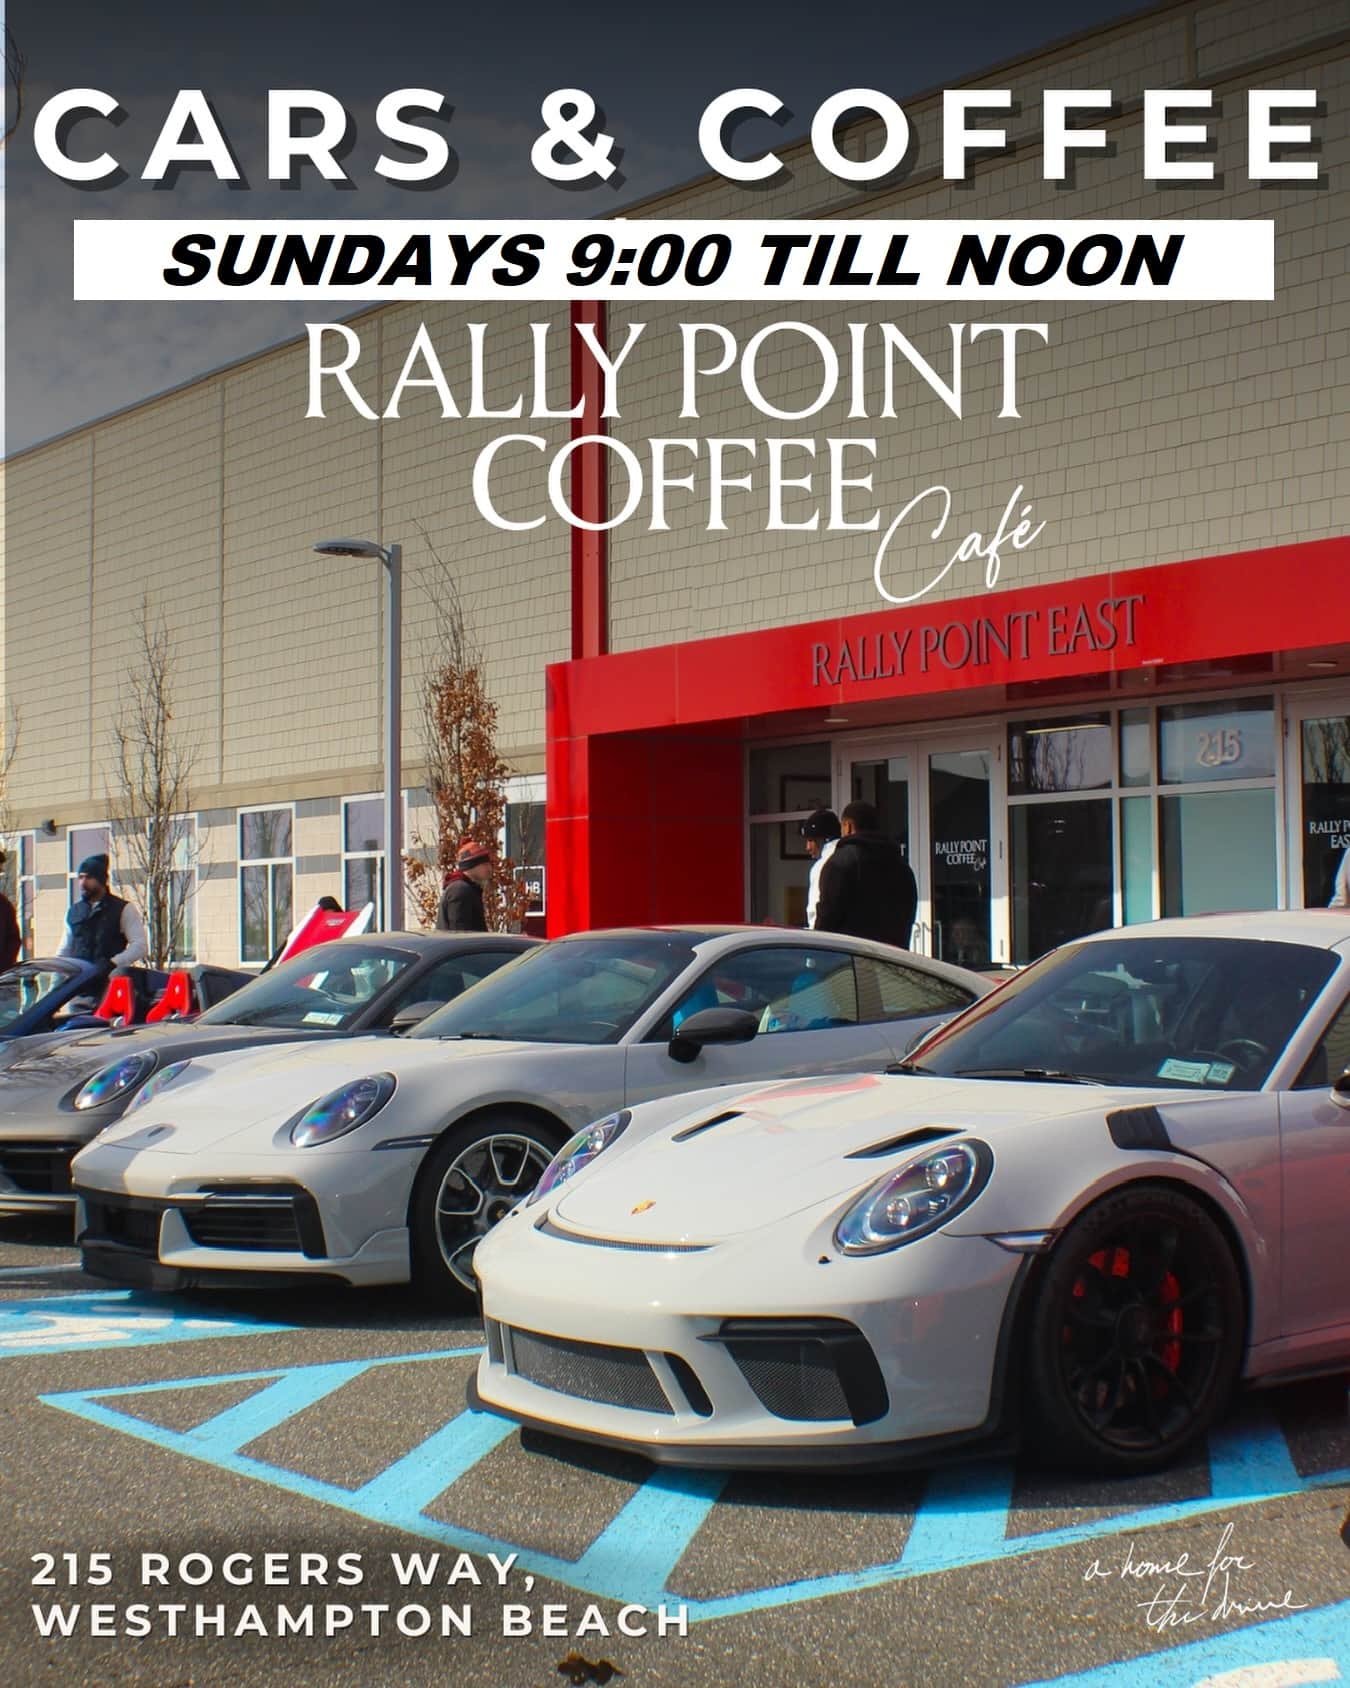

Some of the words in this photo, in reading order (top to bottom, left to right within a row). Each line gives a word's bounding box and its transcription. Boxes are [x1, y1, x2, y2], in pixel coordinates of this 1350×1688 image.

[812, 629, 912, 687] RALLY
[920, 611, 1040, 673] POINT
[1048, 595, 1146, 656] EAST
[1197, 729, 1241, 767] 215
[1309, 820, 1341, 834] RALLY
[935, 841, 960, 855] RALLY
[960, 839, 987, 853] POINT
[946, 853, 977, 865] COFFEE
